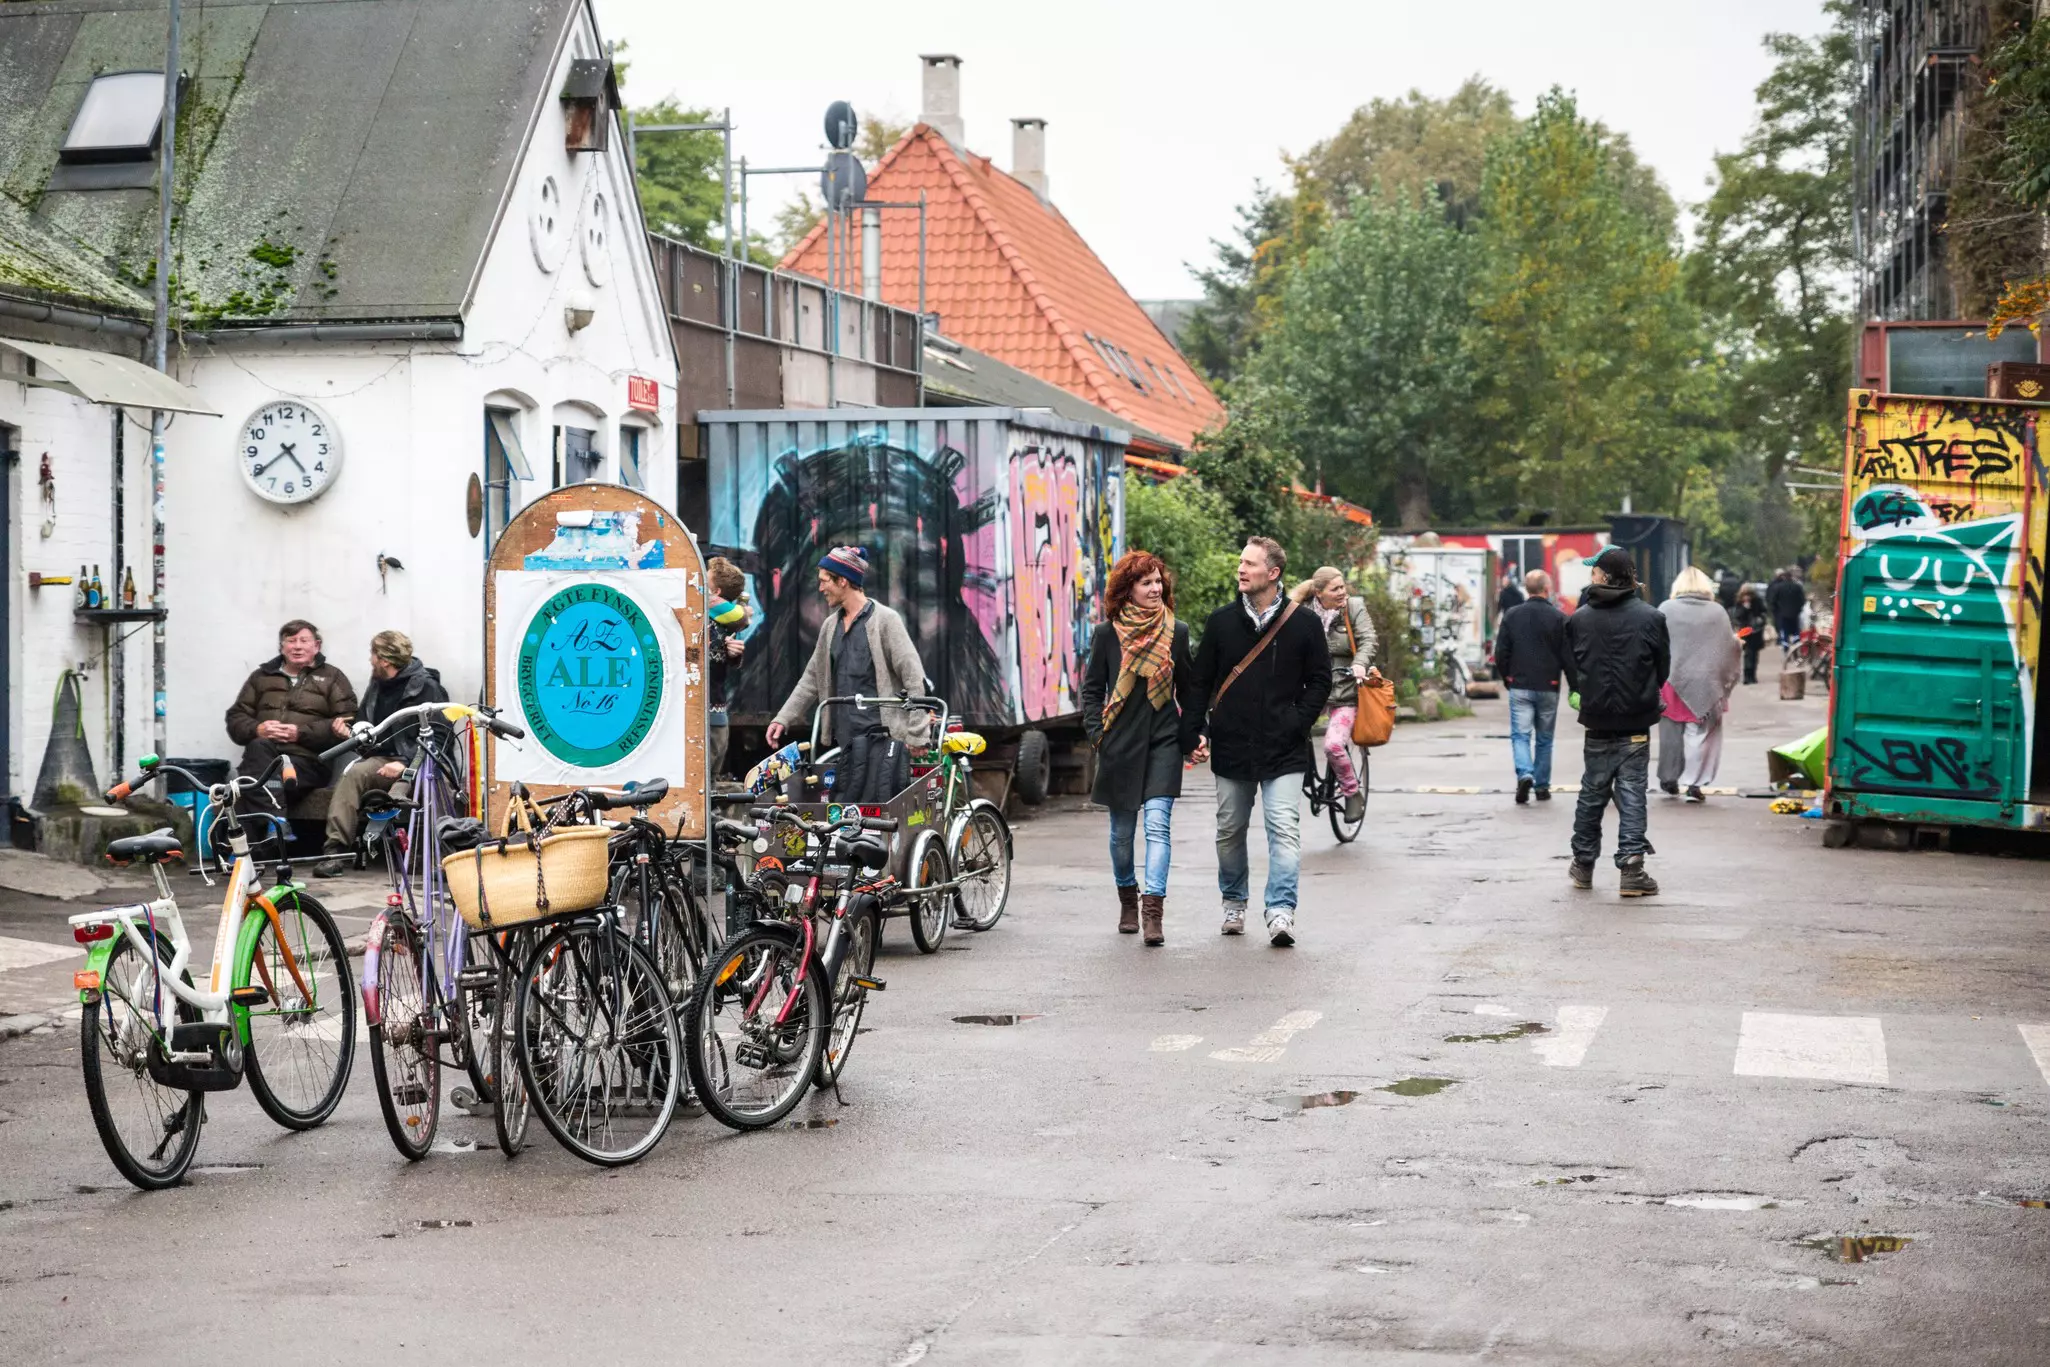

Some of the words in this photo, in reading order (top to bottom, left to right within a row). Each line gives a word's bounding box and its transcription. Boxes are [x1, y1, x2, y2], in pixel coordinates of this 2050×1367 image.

[277, 407, 293, 419] 12
[300, 412, 305, 423] 1
[262, 414, 273, 425] 11
[251, 428, 265, 440] 10
[312, 424, 321, 436] 2
[247, 446, 257, 457] 9
[319, 444, 327, 455] 3
[314, 461, 324, 472] 4
[268, 478, 277, 488] 7
[302, 476, 312, 487] 5
[284, 482, 294, 493] 6
[540, 587, 586, 626] ÆGTE
[591, 587, 643, 626] FYNSK
[545, 656, 632, 687] ALE
[521, 655, 554, 742] BRYGGERIET
[595, 693, 619, 709] 16
[618, 655, 659, 752] REFSVINDINGE
